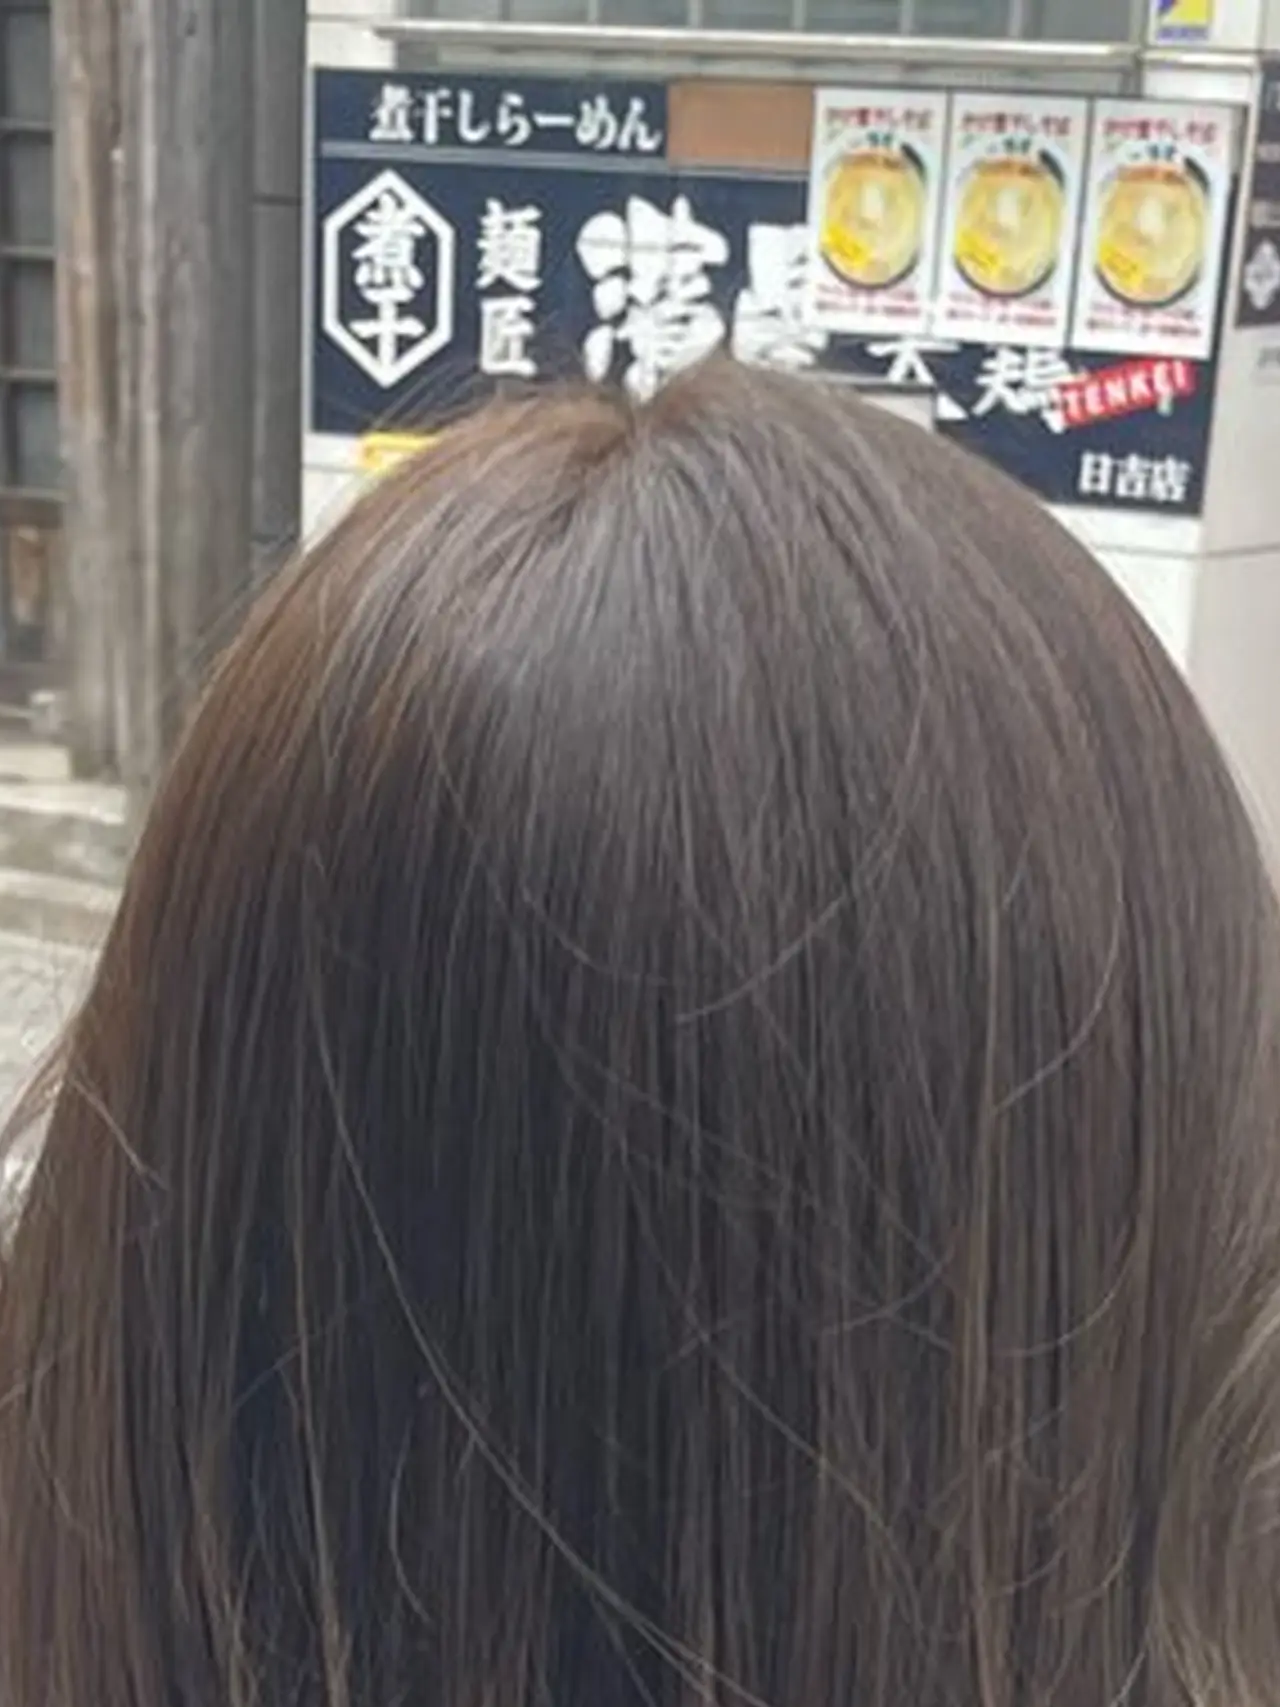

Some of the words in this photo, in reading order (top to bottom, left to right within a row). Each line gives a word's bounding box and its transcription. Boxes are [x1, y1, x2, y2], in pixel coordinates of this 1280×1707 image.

[370, 84, 663, 152] 煮干しらーめん
[1078, 450, 1192, 502] 日吉店
